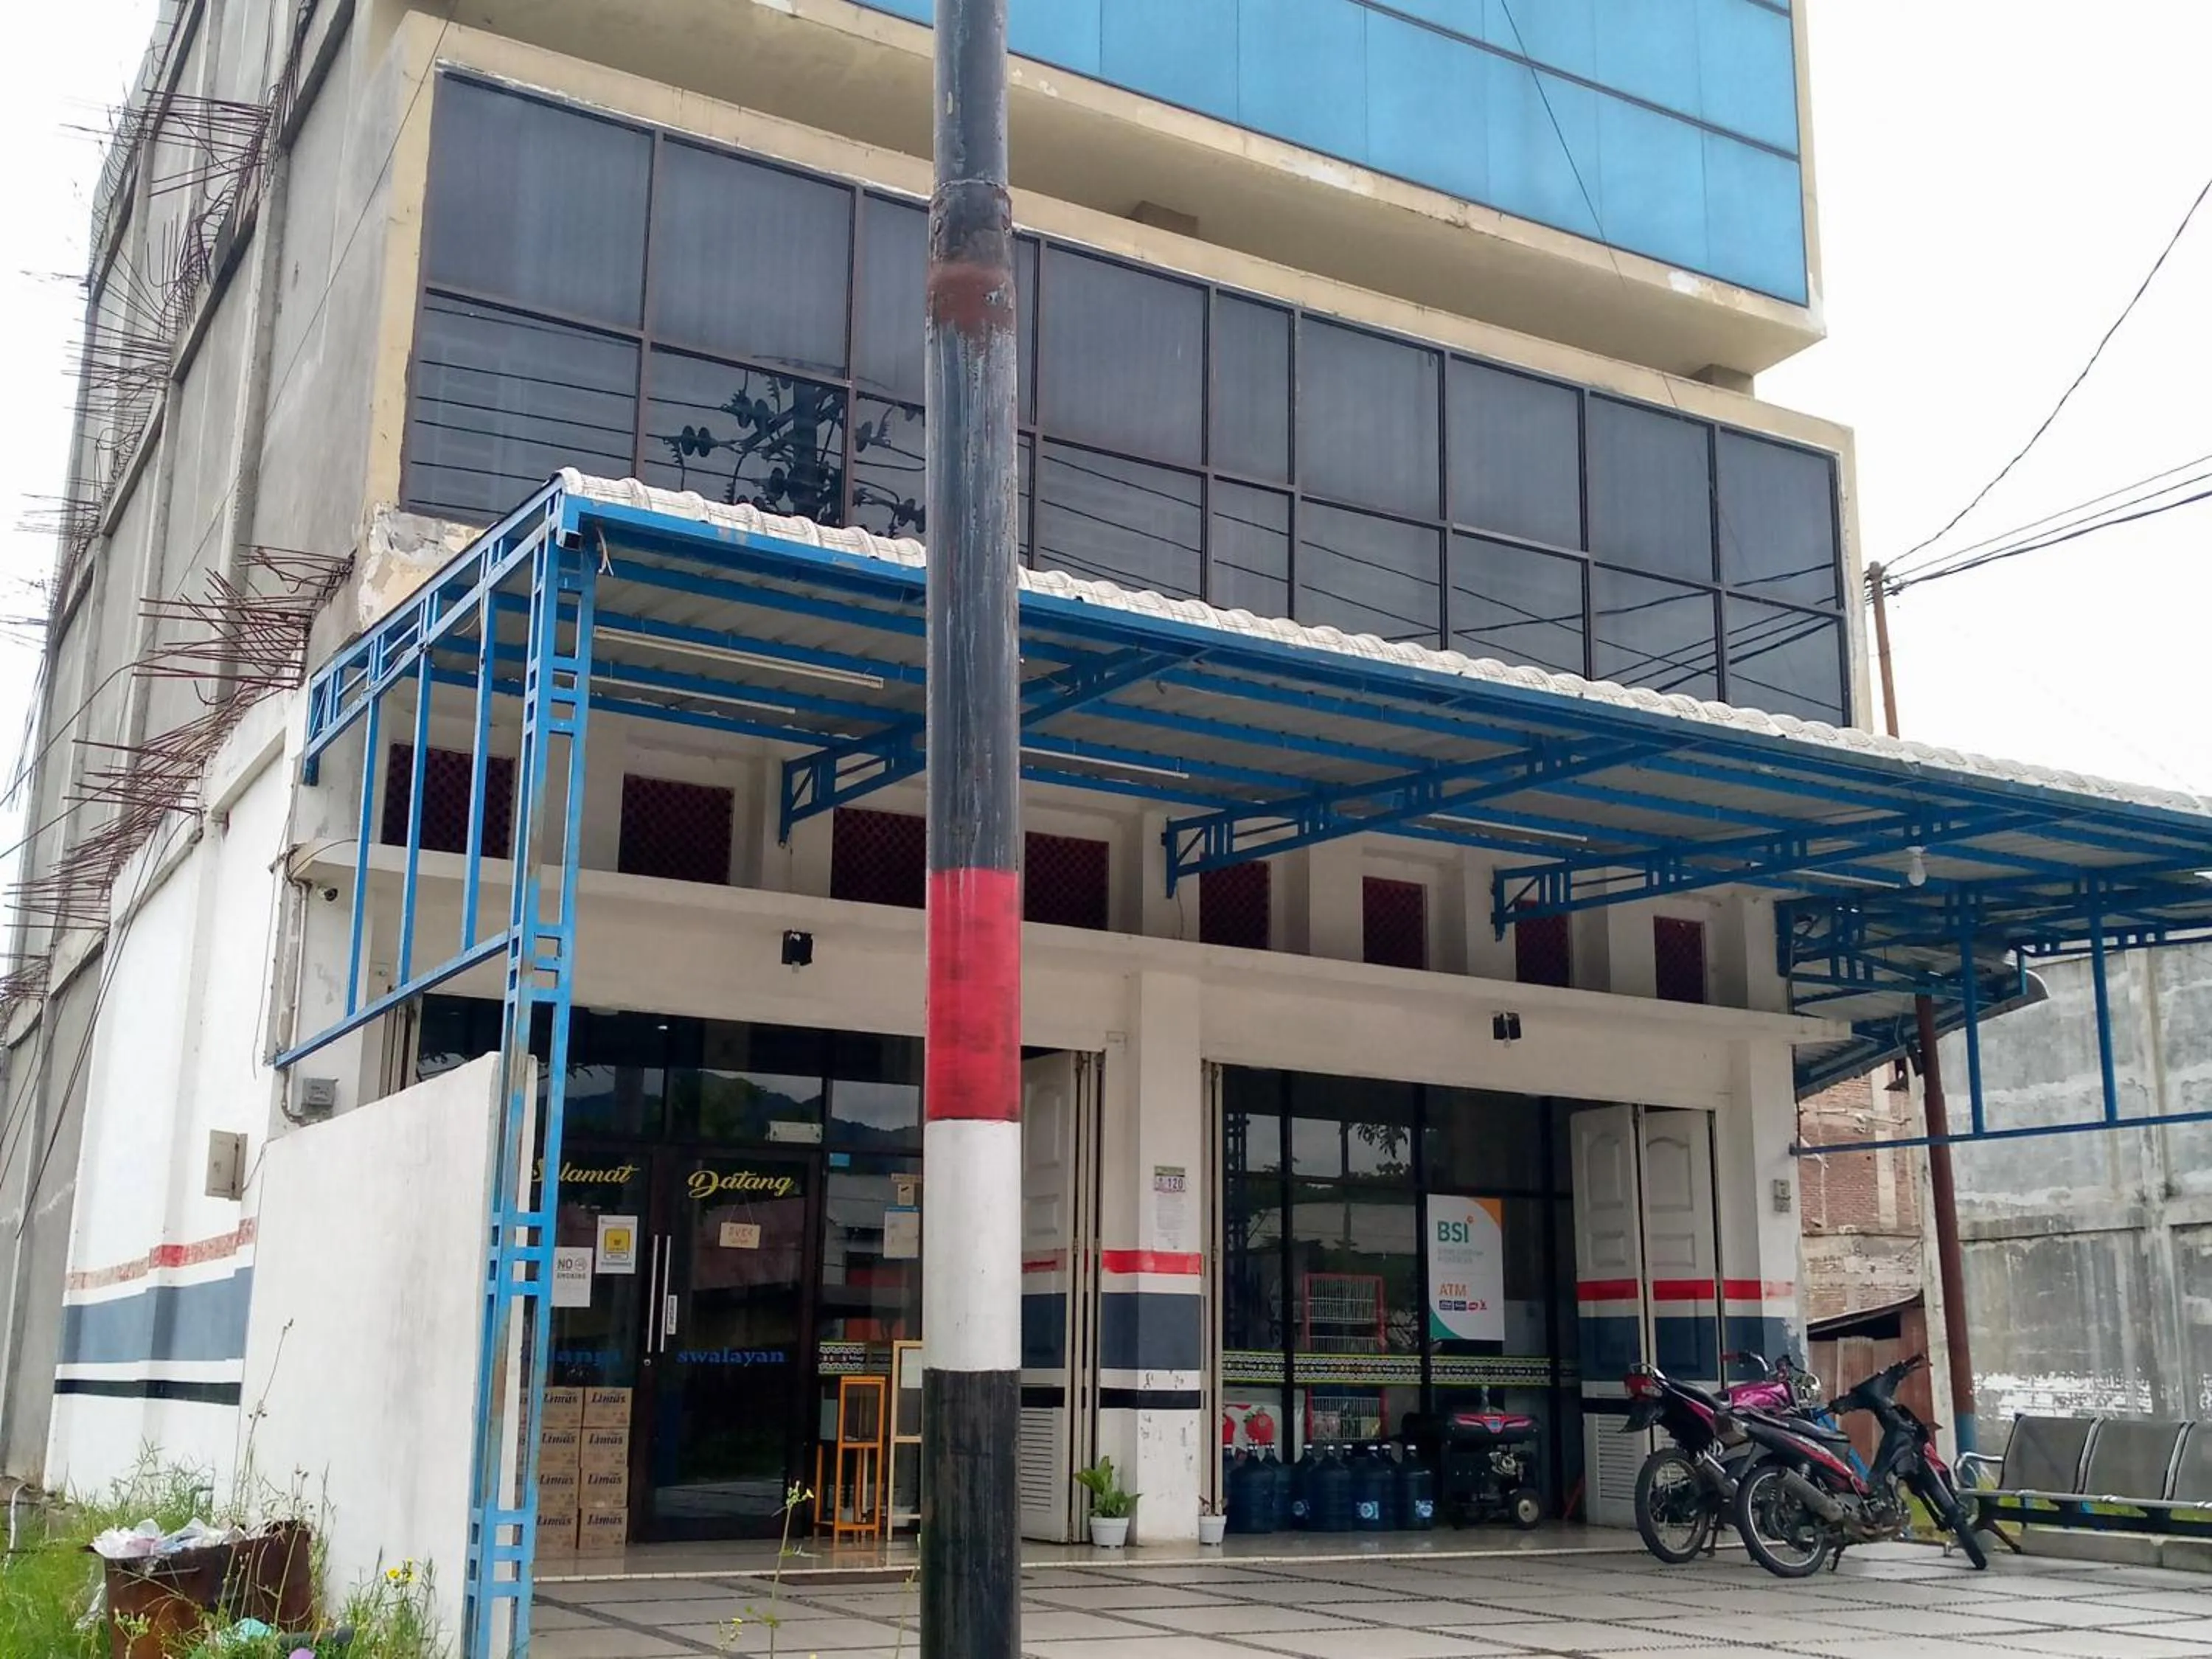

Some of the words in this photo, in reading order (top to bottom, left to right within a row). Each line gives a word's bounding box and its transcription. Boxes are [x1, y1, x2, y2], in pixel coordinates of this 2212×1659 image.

[531, 1158, 640, 1183] Slamat
[688, 1170, 795, 1198] Datang
[1437, 1221, 1469, 1243] BSI
[557, 1258, 573, 1270] NO
[1439, 1283, 1467, 1296] ATM
[676, 1347, 786, 1366] swalayan
[539, 1474, 574, 1485] Limas
[587, 1474, 622, 1485] Limas
[537, 1514, 573, 1526] Limas
[587, 1514, 623, 1526] Limas
